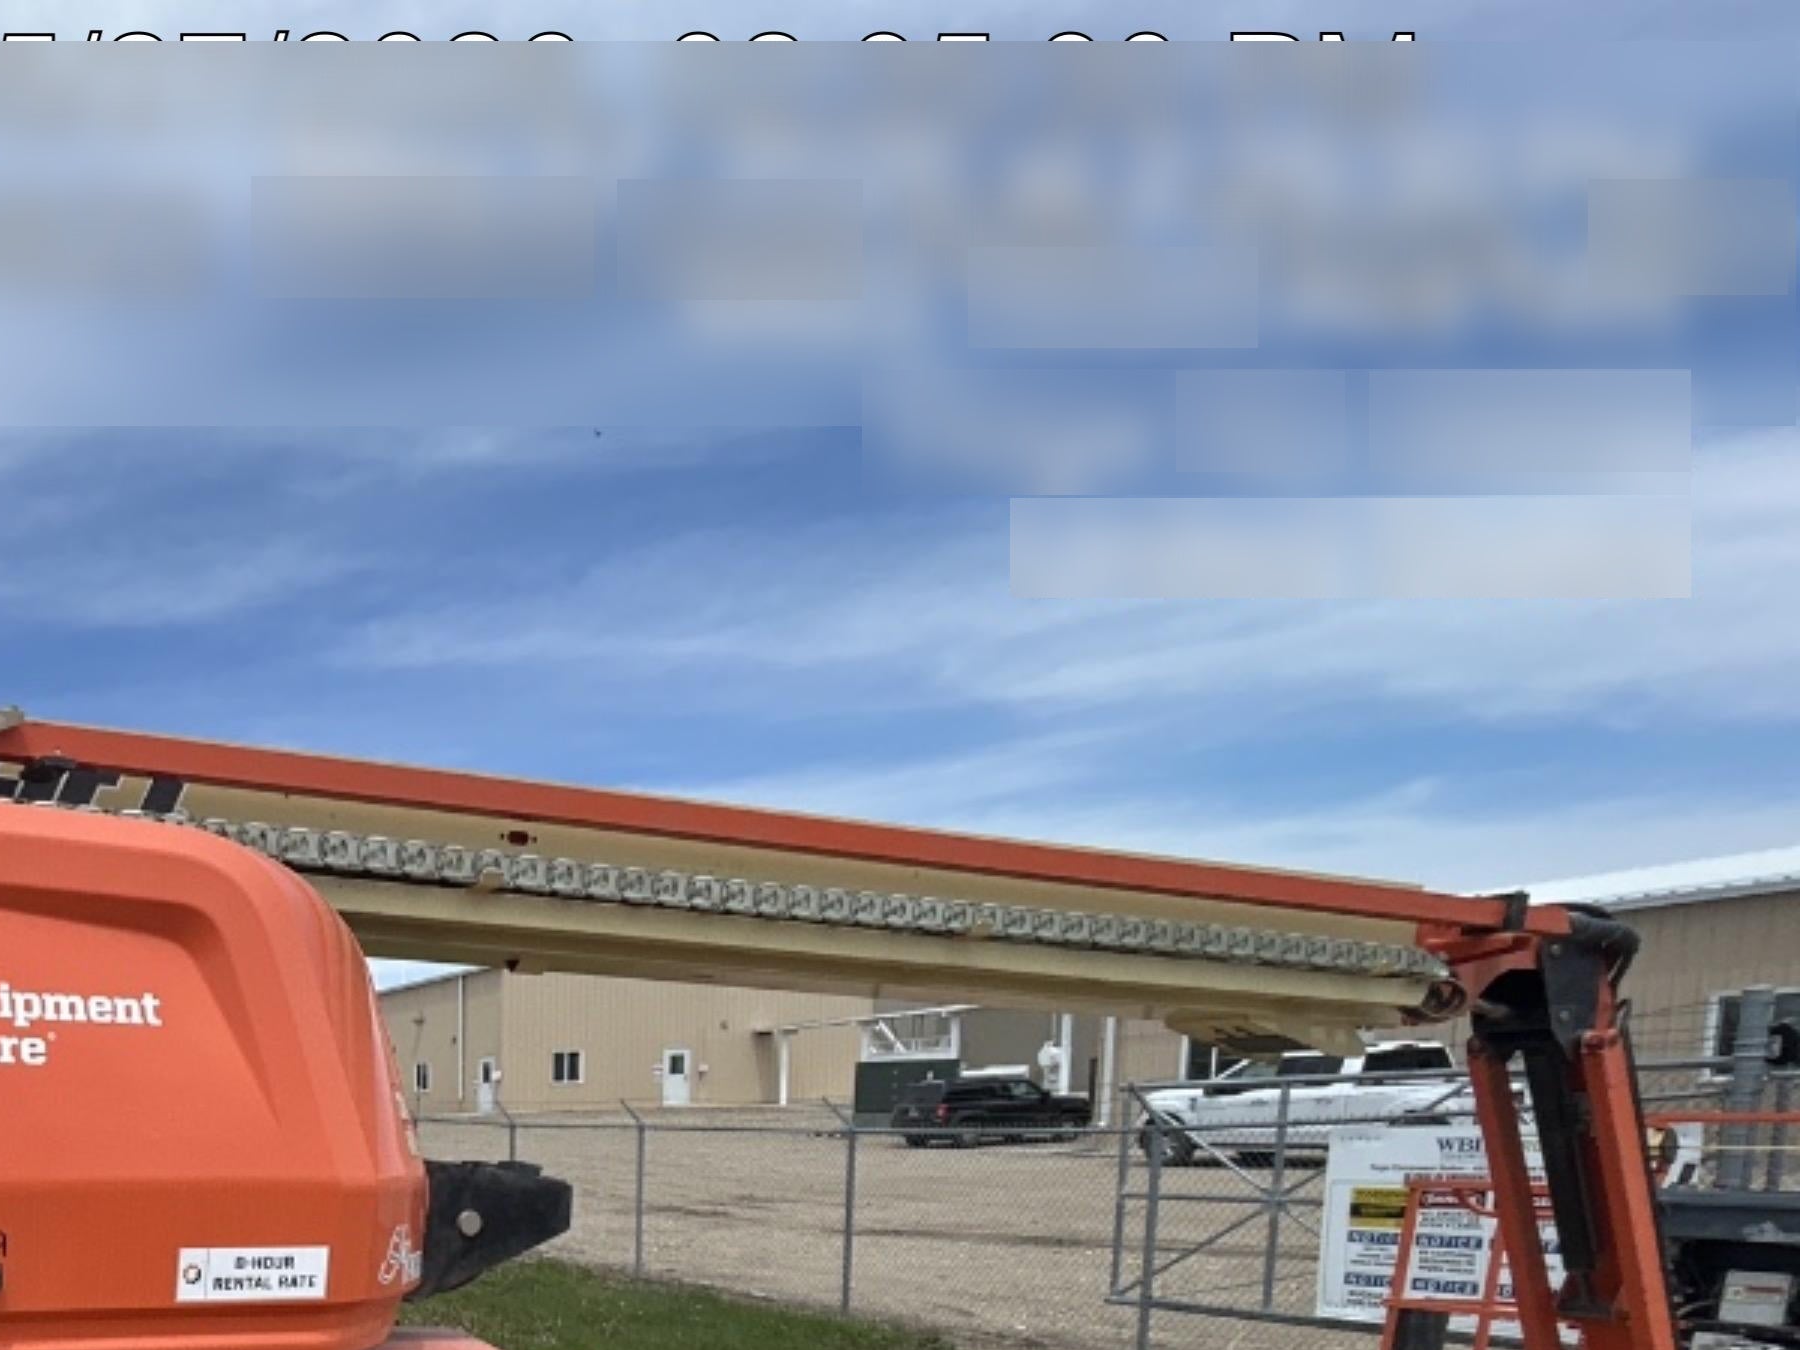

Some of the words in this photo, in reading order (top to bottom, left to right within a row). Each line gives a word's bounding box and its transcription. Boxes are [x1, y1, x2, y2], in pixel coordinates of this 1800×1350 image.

[1436, 1136, 1482, 1153] WBI
[212, 1277, 273, 1291] RENTAL
[278, 1275, 318, 1289] RATE
